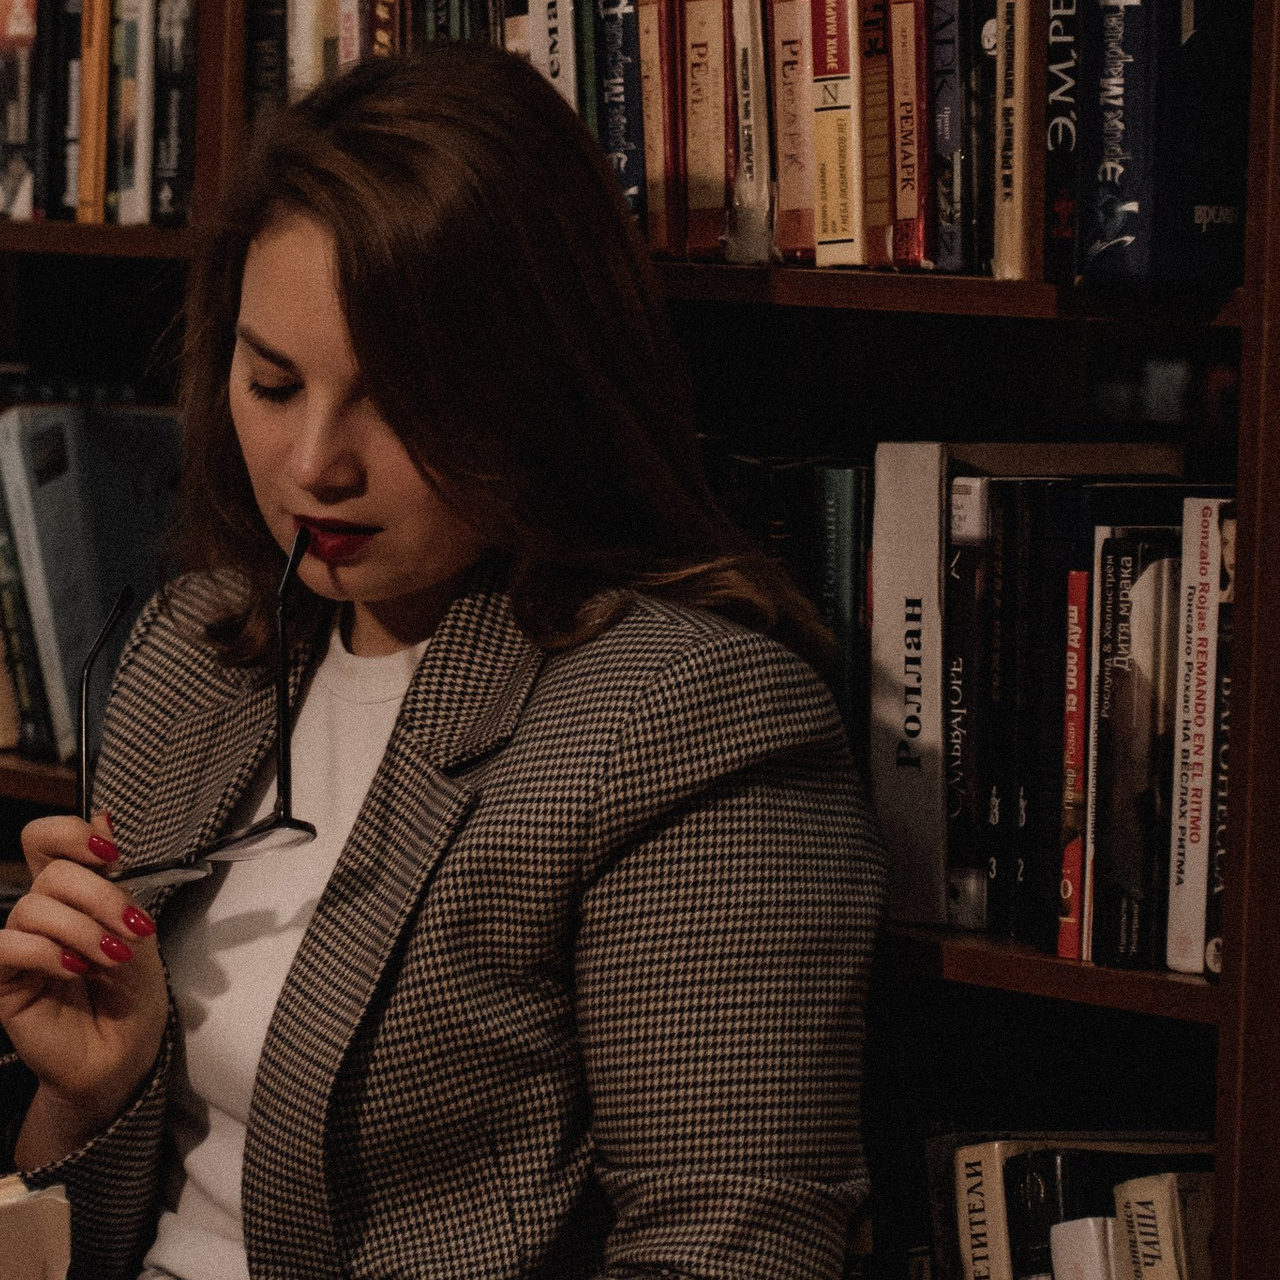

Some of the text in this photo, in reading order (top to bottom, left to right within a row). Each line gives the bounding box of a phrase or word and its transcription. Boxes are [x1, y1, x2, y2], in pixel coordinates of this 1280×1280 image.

[825, 37, 840, 71] ЭРИХ
[899, 100, 916, 192] РЕМАРК
[1113, 621, 1134, 672] Дитя
[1182, 584, 1196, 657] Гонсало
[895, 595, 923, 771] Роллан
[1100, 652, 1114, 719] Рослунд
[1181, 661, 1193, 715] Рохас
[1189, 505, 1213, 845] Gonzalo Rojas REMANDO EN EL RITMO
[1179, 719, 1192, 746] НА
[988, 855, 998, 880] 3
[1016, 857, 1026, 883] 2
[1174, 825, 1188, 887] РИТМА
[1135, 1198, 1163, 1268] ЧАША
